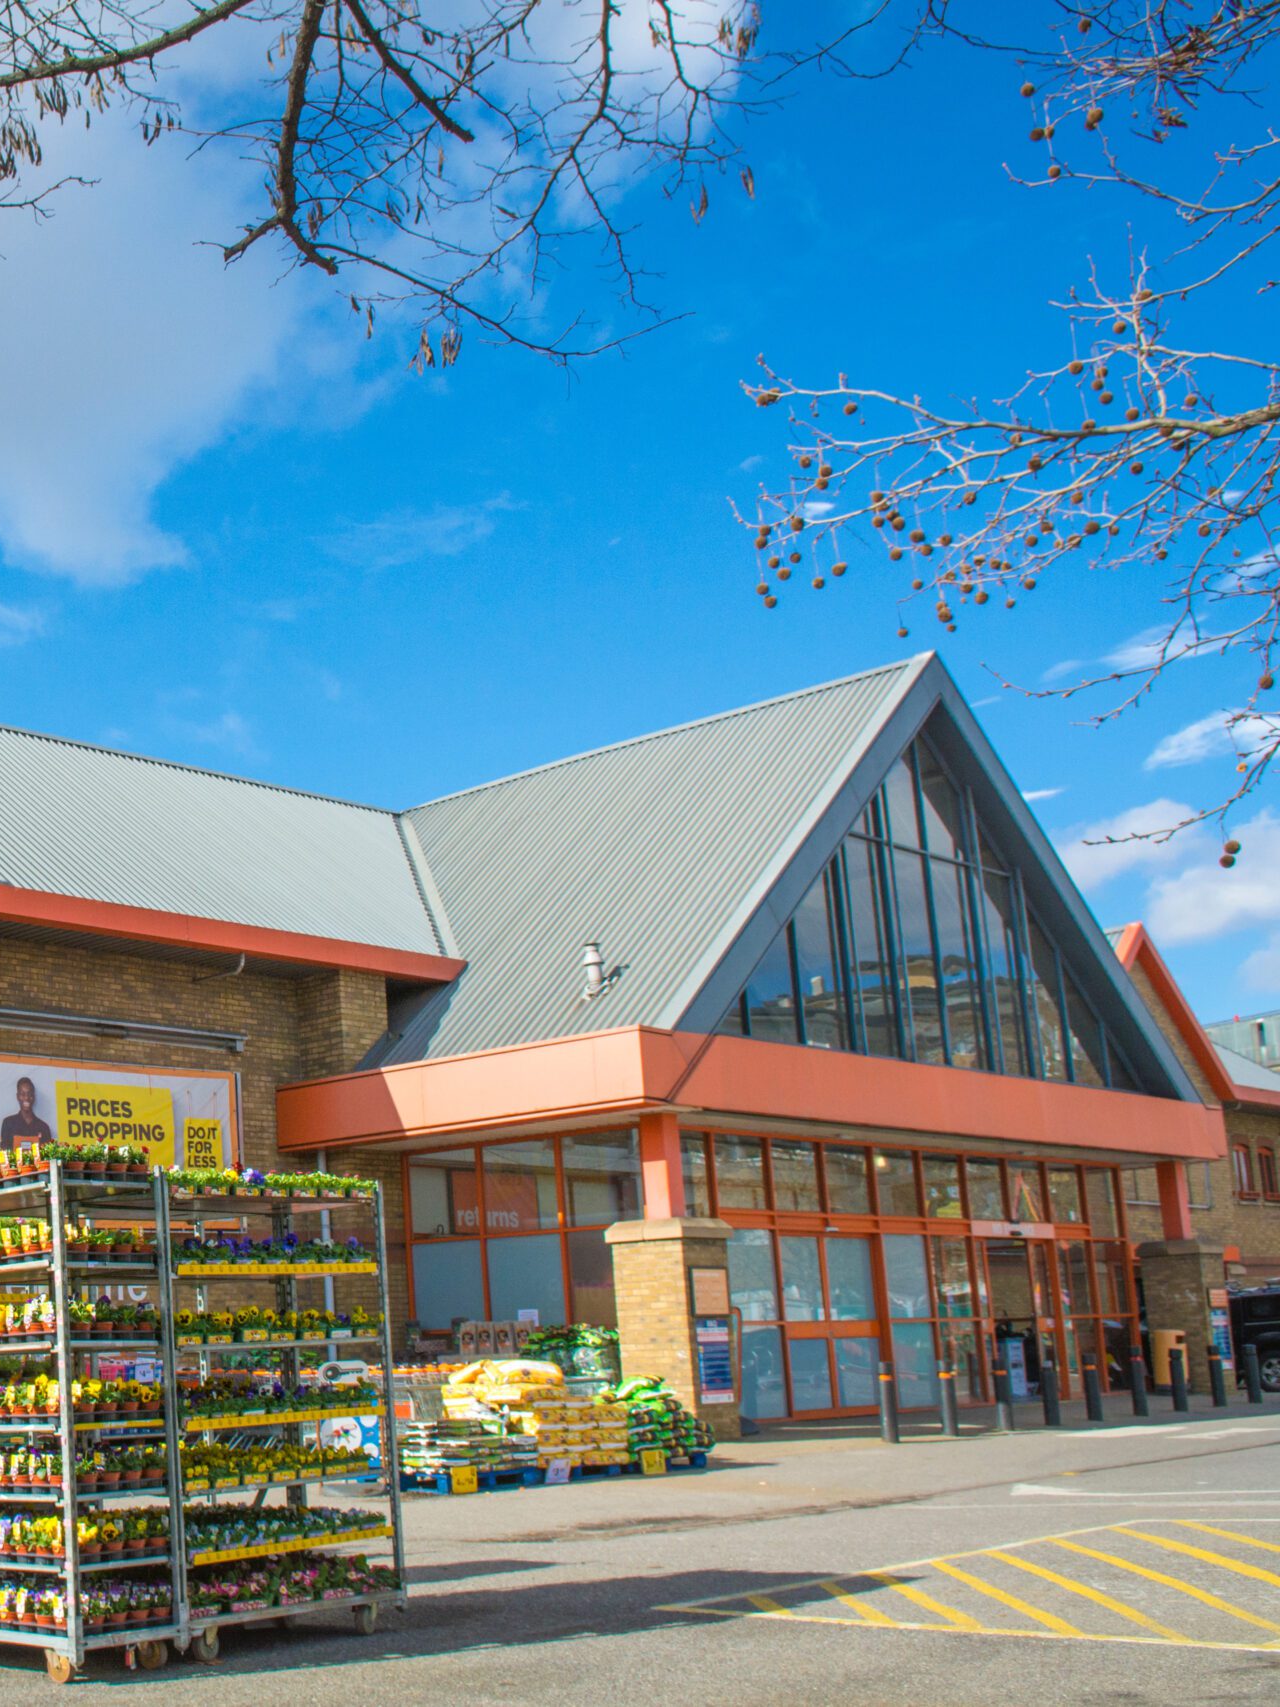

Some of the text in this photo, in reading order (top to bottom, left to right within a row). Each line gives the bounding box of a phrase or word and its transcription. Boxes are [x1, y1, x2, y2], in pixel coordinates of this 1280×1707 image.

[66, 1097, 133, 1118] PRICES
[68, 1120, 165, 1142] DROPPING
[187, 1126, 217, 1140] DO IT
[187, 1141, 212, 1154] FOR
[187, 1155, 217, 1168] LESS
